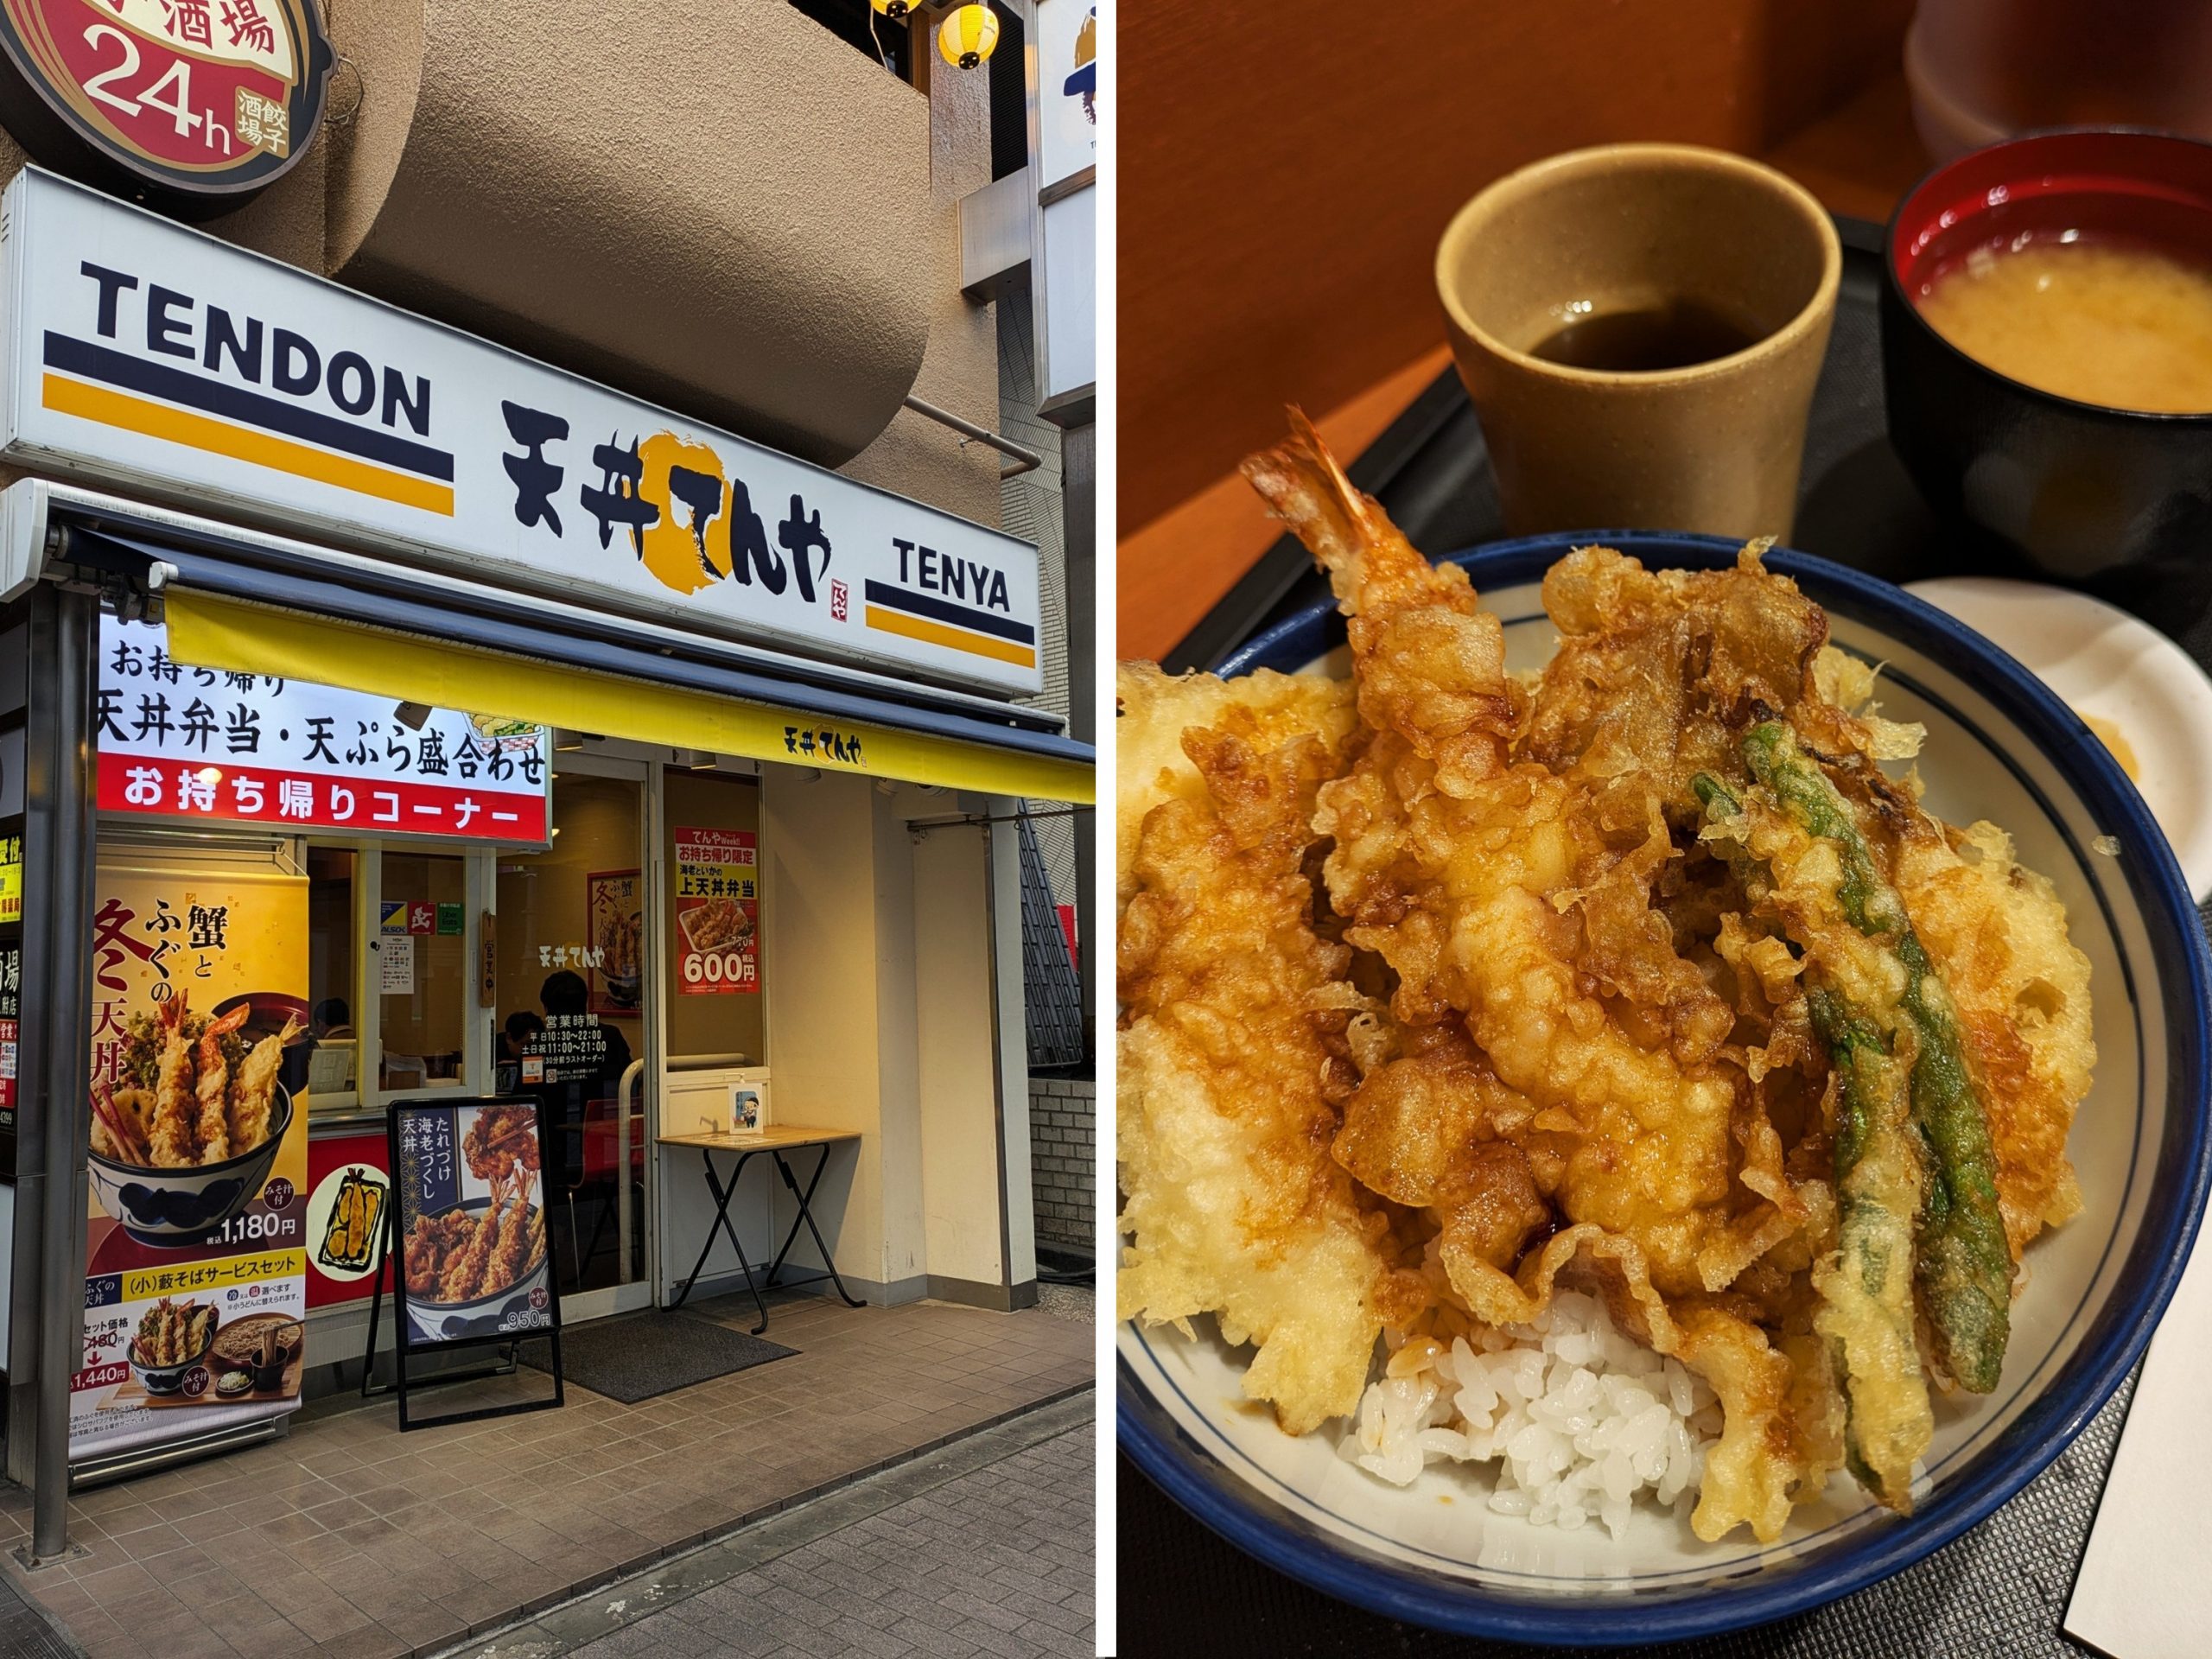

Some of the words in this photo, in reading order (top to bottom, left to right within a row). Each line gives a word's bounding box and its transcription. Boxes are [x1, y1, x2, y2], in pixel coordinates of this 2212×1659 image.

[116, 0, 276, 54] 酒場
[80, 260, 431, 437] TENDON
[501, 399, 832, 603] 天丼てんや
[892, 537, 1011, 613] TENYA
[124, 766, 519, 830] お持ち帰りコーナー
[679, 846, 753, 864] お持ち帰り限定
[680, 864, 722, 876] 海老といかの
[680, 877, 754, 898] 上天丼弁当
[145, 899, 181, 1003] ふぐの
[188, 905, 228, 977] 蟹と
[546, 1014, 599, 1028] 営業時間
[403, 1119, 418, 1153] 天丼
[418, 1117, 435, 1199] 海老づくし
[435, 1116, 452, 1181] たれづけ
[265, 1184, 293, 1195] みそ汁
[275, 1195, 283, 1205] 付
[84, 1318, 128, 1333] セット価格
[71, 1367, 125, 1389] 1,440円
